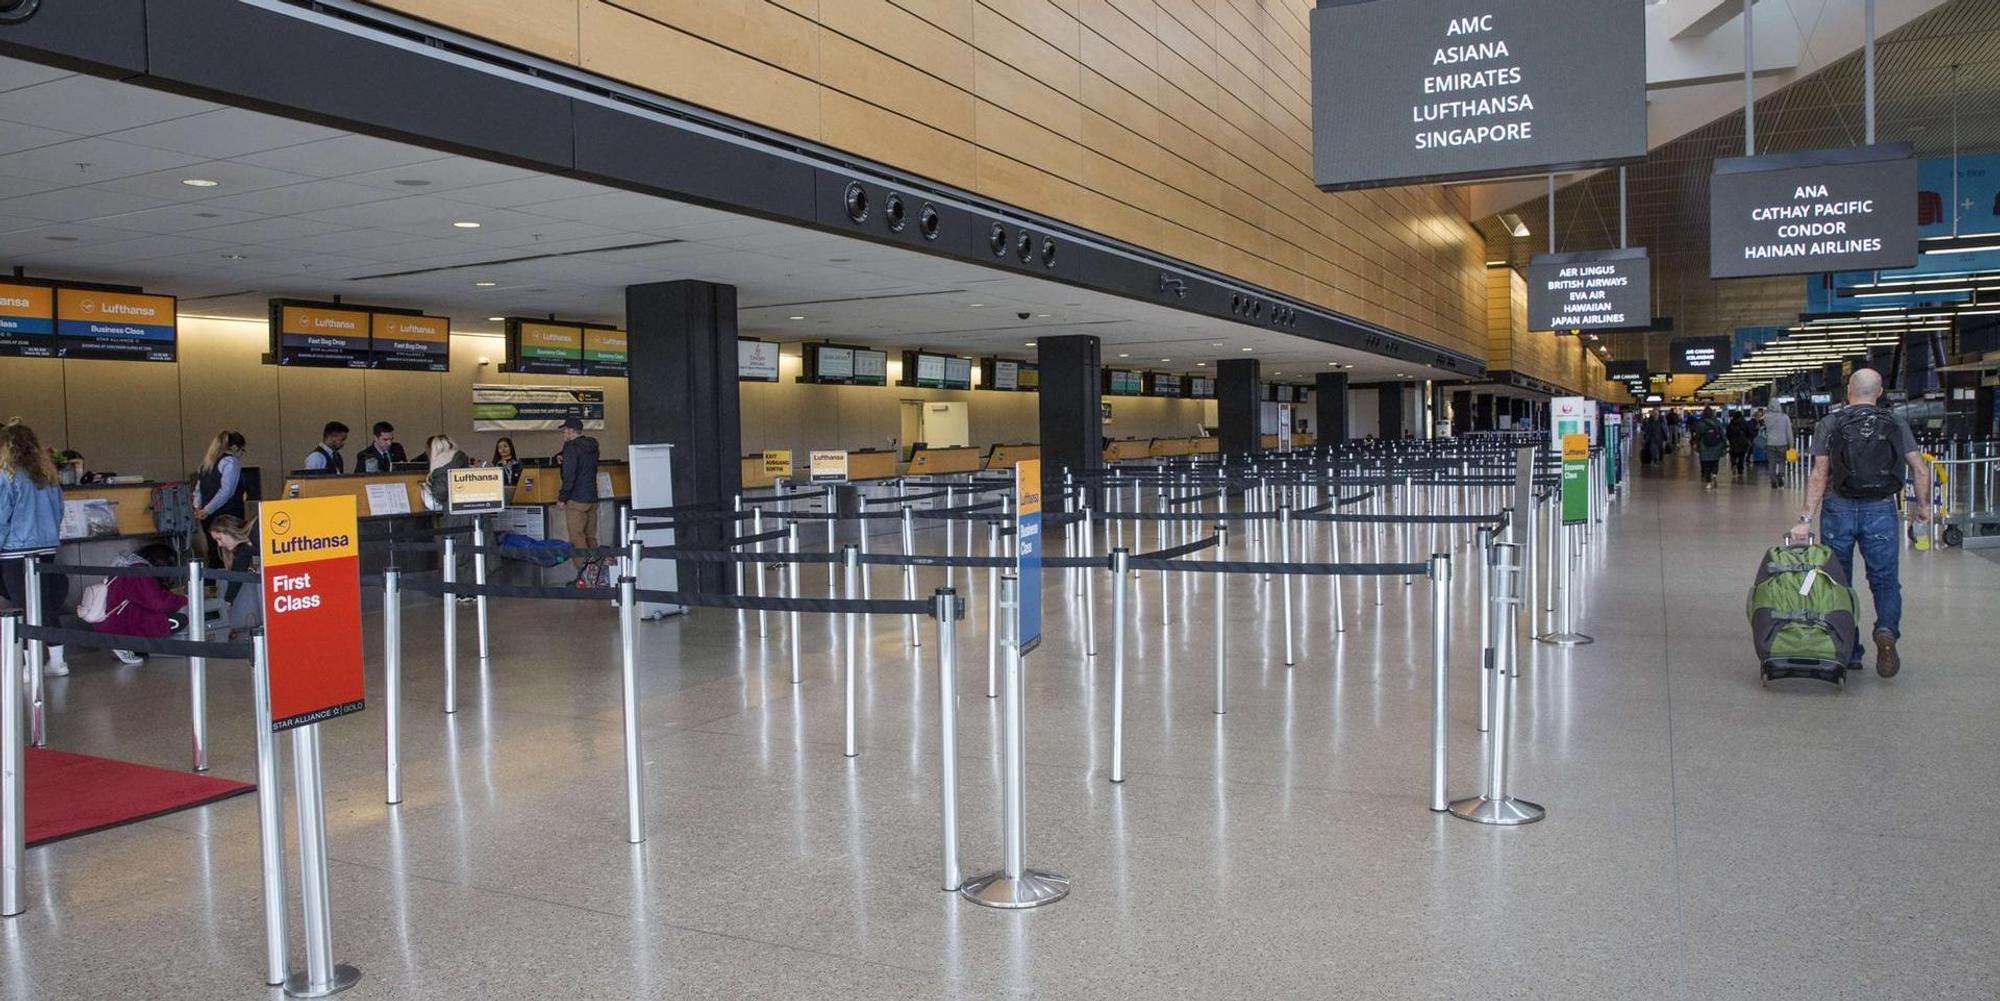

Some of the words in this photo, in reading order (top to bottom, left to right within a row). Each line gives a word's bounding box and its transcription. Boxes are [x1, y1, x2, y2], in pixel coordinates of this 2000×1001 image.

[1446, 14, 1493, 36] AMC
[1433, 40, 1509, 66] ASIANA
[1423, 66, 1521, 94] EMIRATES
[1413, 93, 1534, 122] LUFTHANSA
[1415, 121, 1532, 149] SINGAPORE
[1793, 184, 1829, 199] ANA
[1751, 204, 1811, 221] CATHAY
[1814, 200, 1873, 217] PACIFIC
[1777, 221, 1846, 238] CONDOR
[1744, 242, 1806, 259] HAINAN
[1809, 238, 1882, 255] AIRLINES
[1559, 267, 1578, 277] AER
[1580, 265, 1615, 276] LINGUS
[1547, 279, 1584, 290] BRITISH
[1586, 277, 1628, 288] AIRWAYS
[0, 297, 30, 307] ansa
[1569, 291, 1587, 301] EVA
[1588, 290, 1606, 300] AIR
[101, 303, 155, 316] Lufthansa
[1563, 302, 1612, 313] HAWAIIAN
[0, 320, 17, 328] lass
[315, 318, 355, 329] Lufthansa
[1550, 316, 1581, 328] JAPAN
[1582, 313, 1625, 324] AIRLINES
[90, 325, 124, 334] Business
[400, 324, 435, 334] Lufthansa
[308, 337, 321, 345] Fast
[321, 338, 332, 347] Bag
[332, 339, 346, 347] Drop
[1564, 463, 1586, 471] Economy
[454, 473, 499, 483] Lufthansa
[1564, 471, 1578, 479] Class
[272, 534, 349, 555] Lufthansa
[273, 573, 311, 592] First
[274, 594, 321, 613] Class
[272, 719, 293, 731] STAR
[294, 710, 332, 725] ALLIANCE
[344, 702, 364, 712] GOLD
